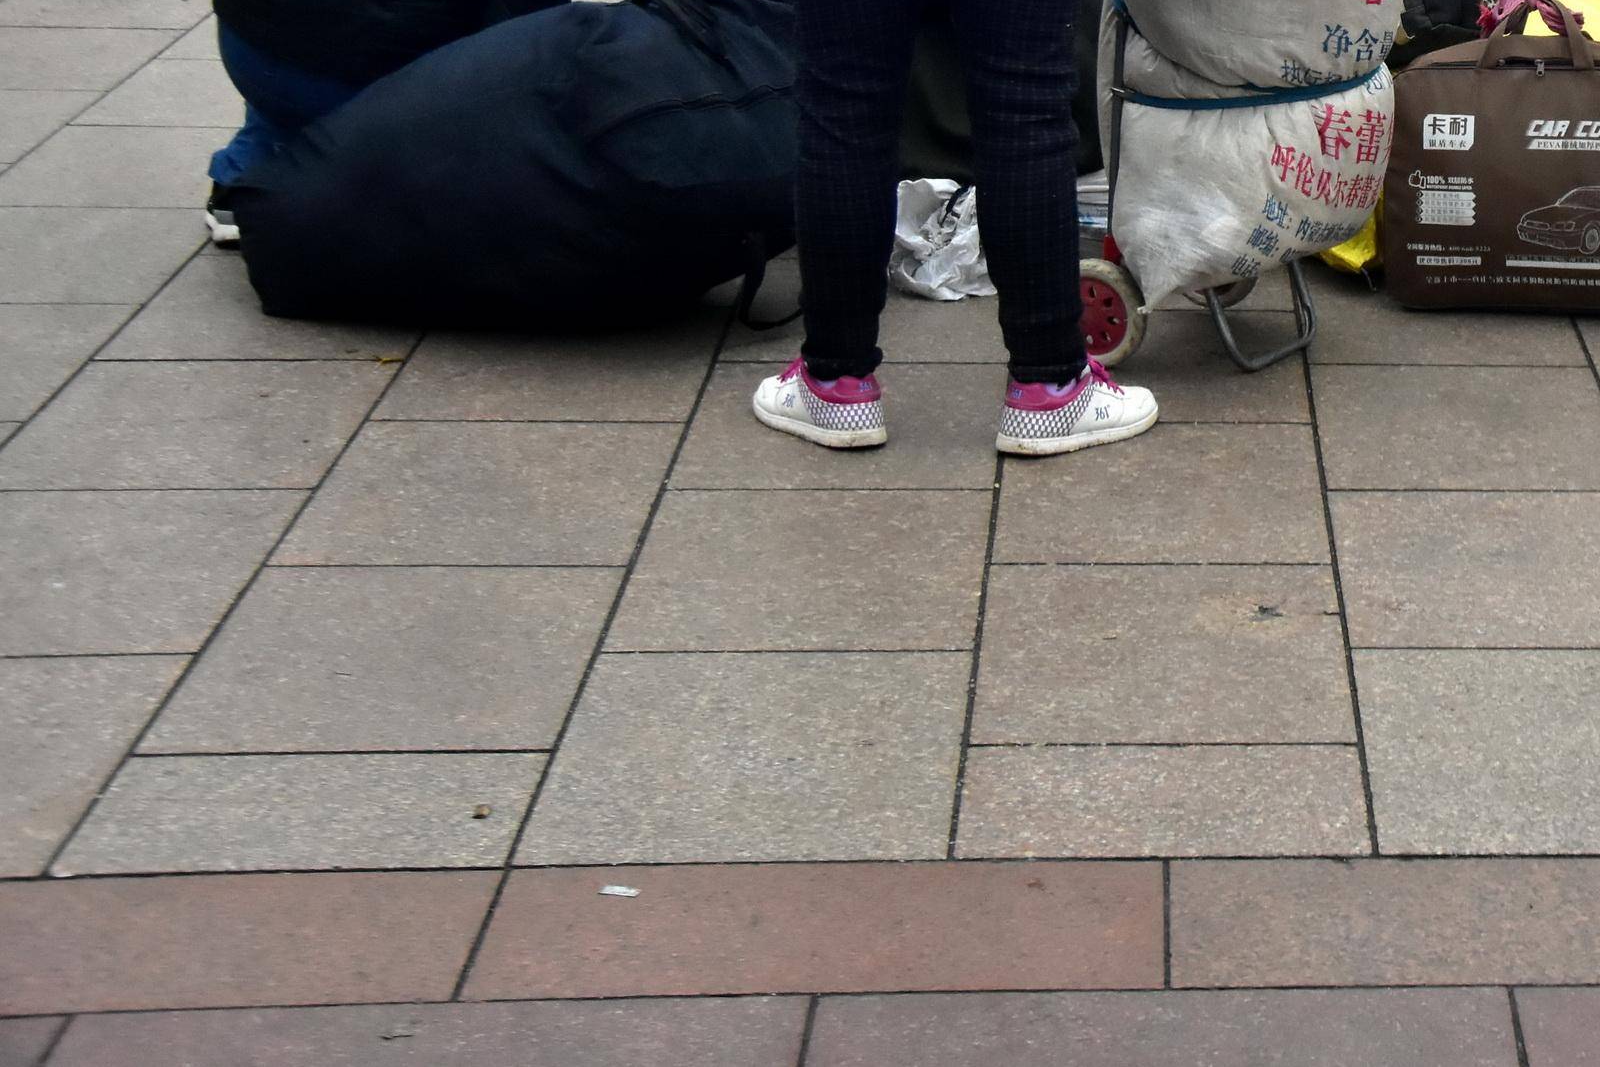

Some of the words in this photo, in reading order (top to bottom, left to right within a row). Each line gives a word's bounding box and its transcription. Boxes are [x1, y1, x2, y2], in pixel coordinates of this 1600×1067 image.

[1322, 23, 1394, 63] 净含量
[1311, 102, 1394, 166] 春蕾
[1427, 116, 1468, 136] 卡耐
[1525, 119, 1570, 138] CAR
[1426, 174, 1446, 185] 100%
